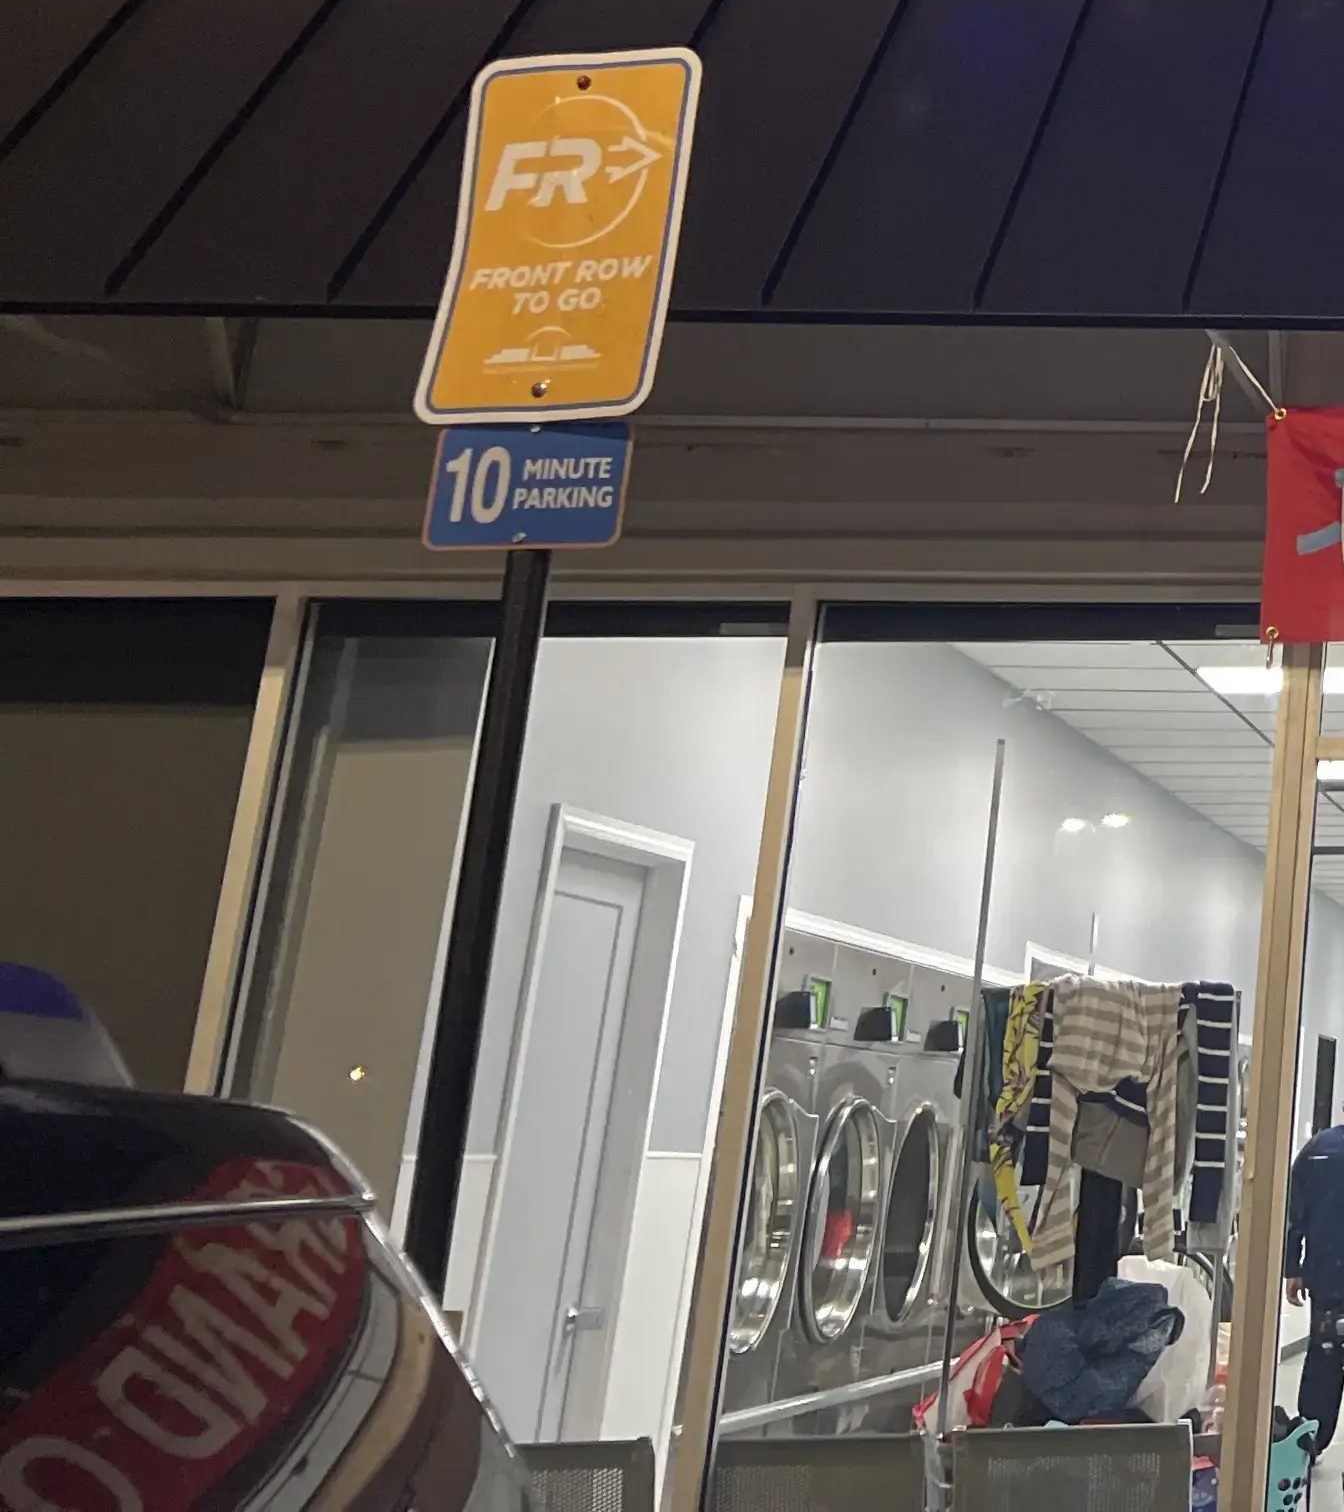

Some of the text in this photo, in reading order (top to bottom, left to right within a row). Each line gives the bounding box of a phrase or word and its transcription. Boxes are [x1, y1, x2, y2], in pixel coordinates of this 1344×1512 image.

[484, 136, 602, 212] FR
[469, 255, 653, 290] FRONT ROW
[512, 287, 602, 315] TO GO
[523, 456, 613, 481] MINUTE
[446, 446, 511, 523] 10
[512, 486, 613, 510] PARKING
